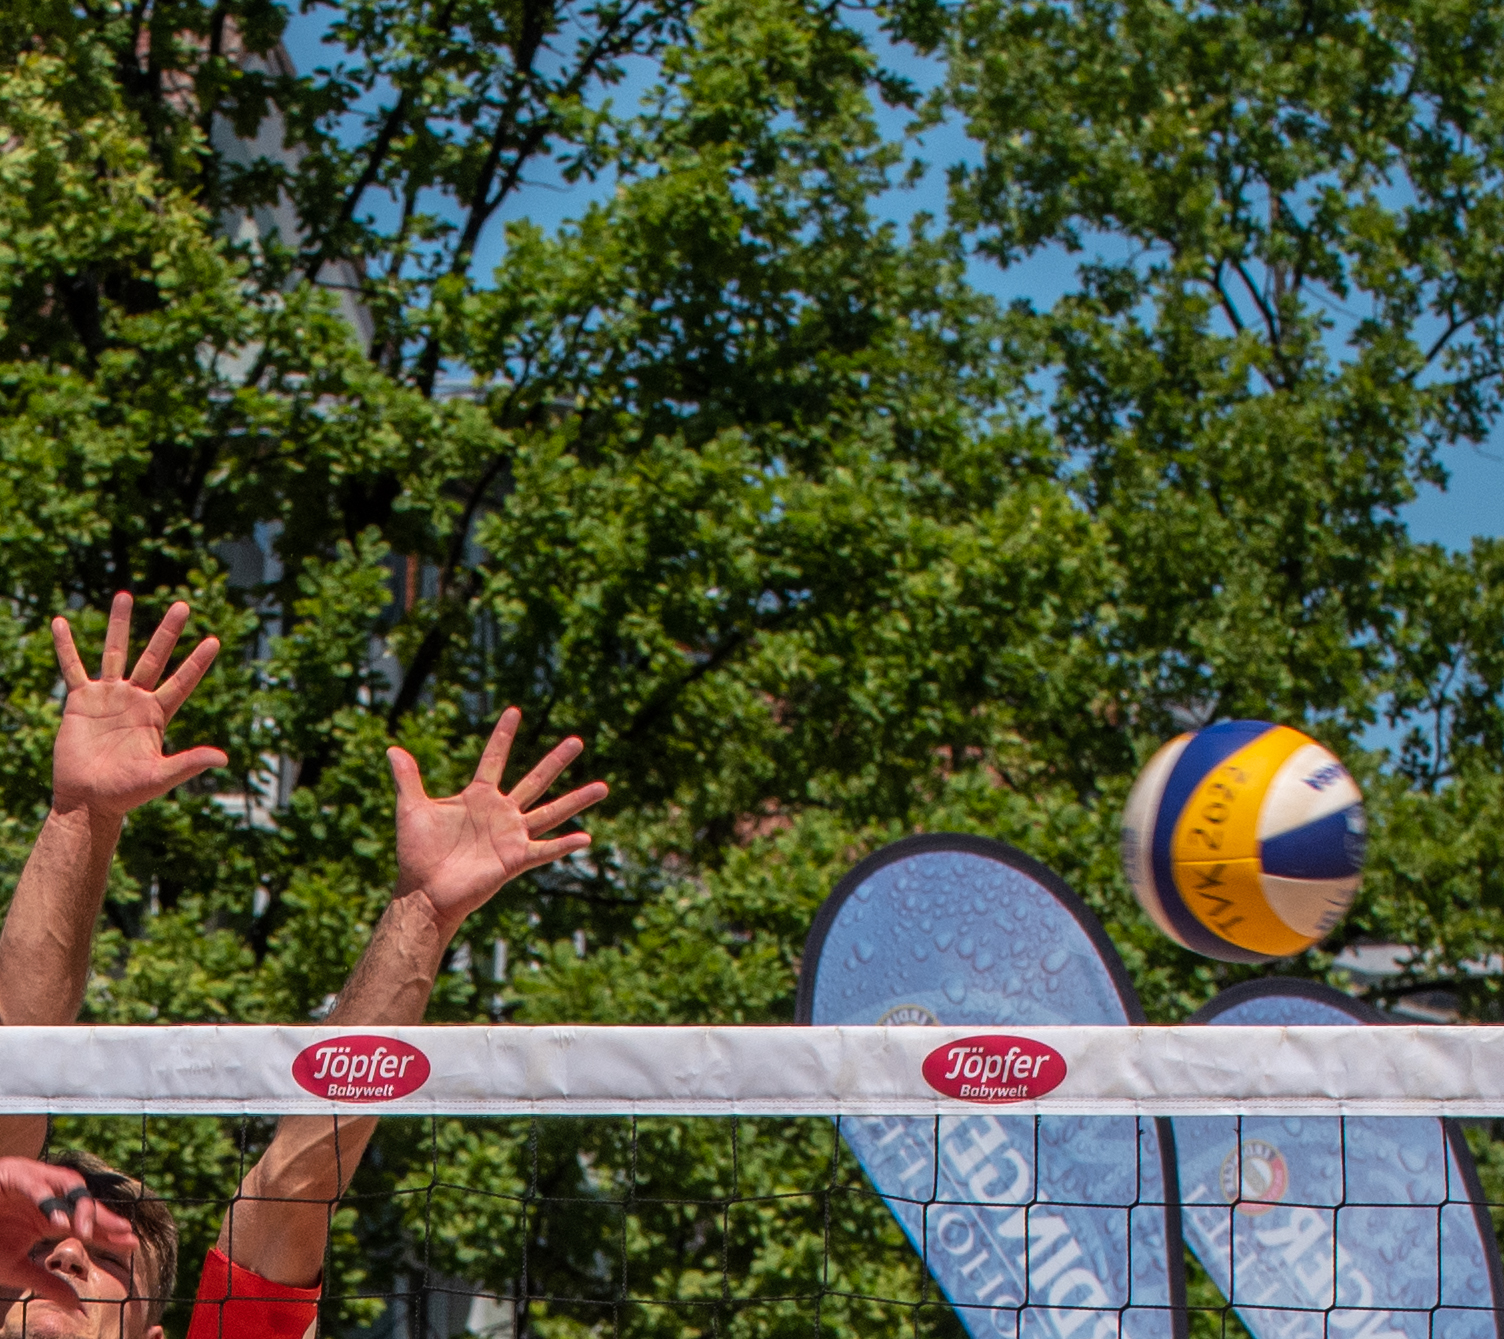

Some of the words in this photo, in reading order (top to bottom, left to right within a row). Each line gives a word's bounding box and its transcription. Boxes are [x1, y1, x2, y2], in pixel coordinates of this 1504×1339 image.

[313, 1046, 415, 1083] Töpfer
[944, 1046, 1051, 1083] Töpfer
[327, 1083, 395, 1099] Babywelt
[960, 1084, 1028, 1101] Babywelt
